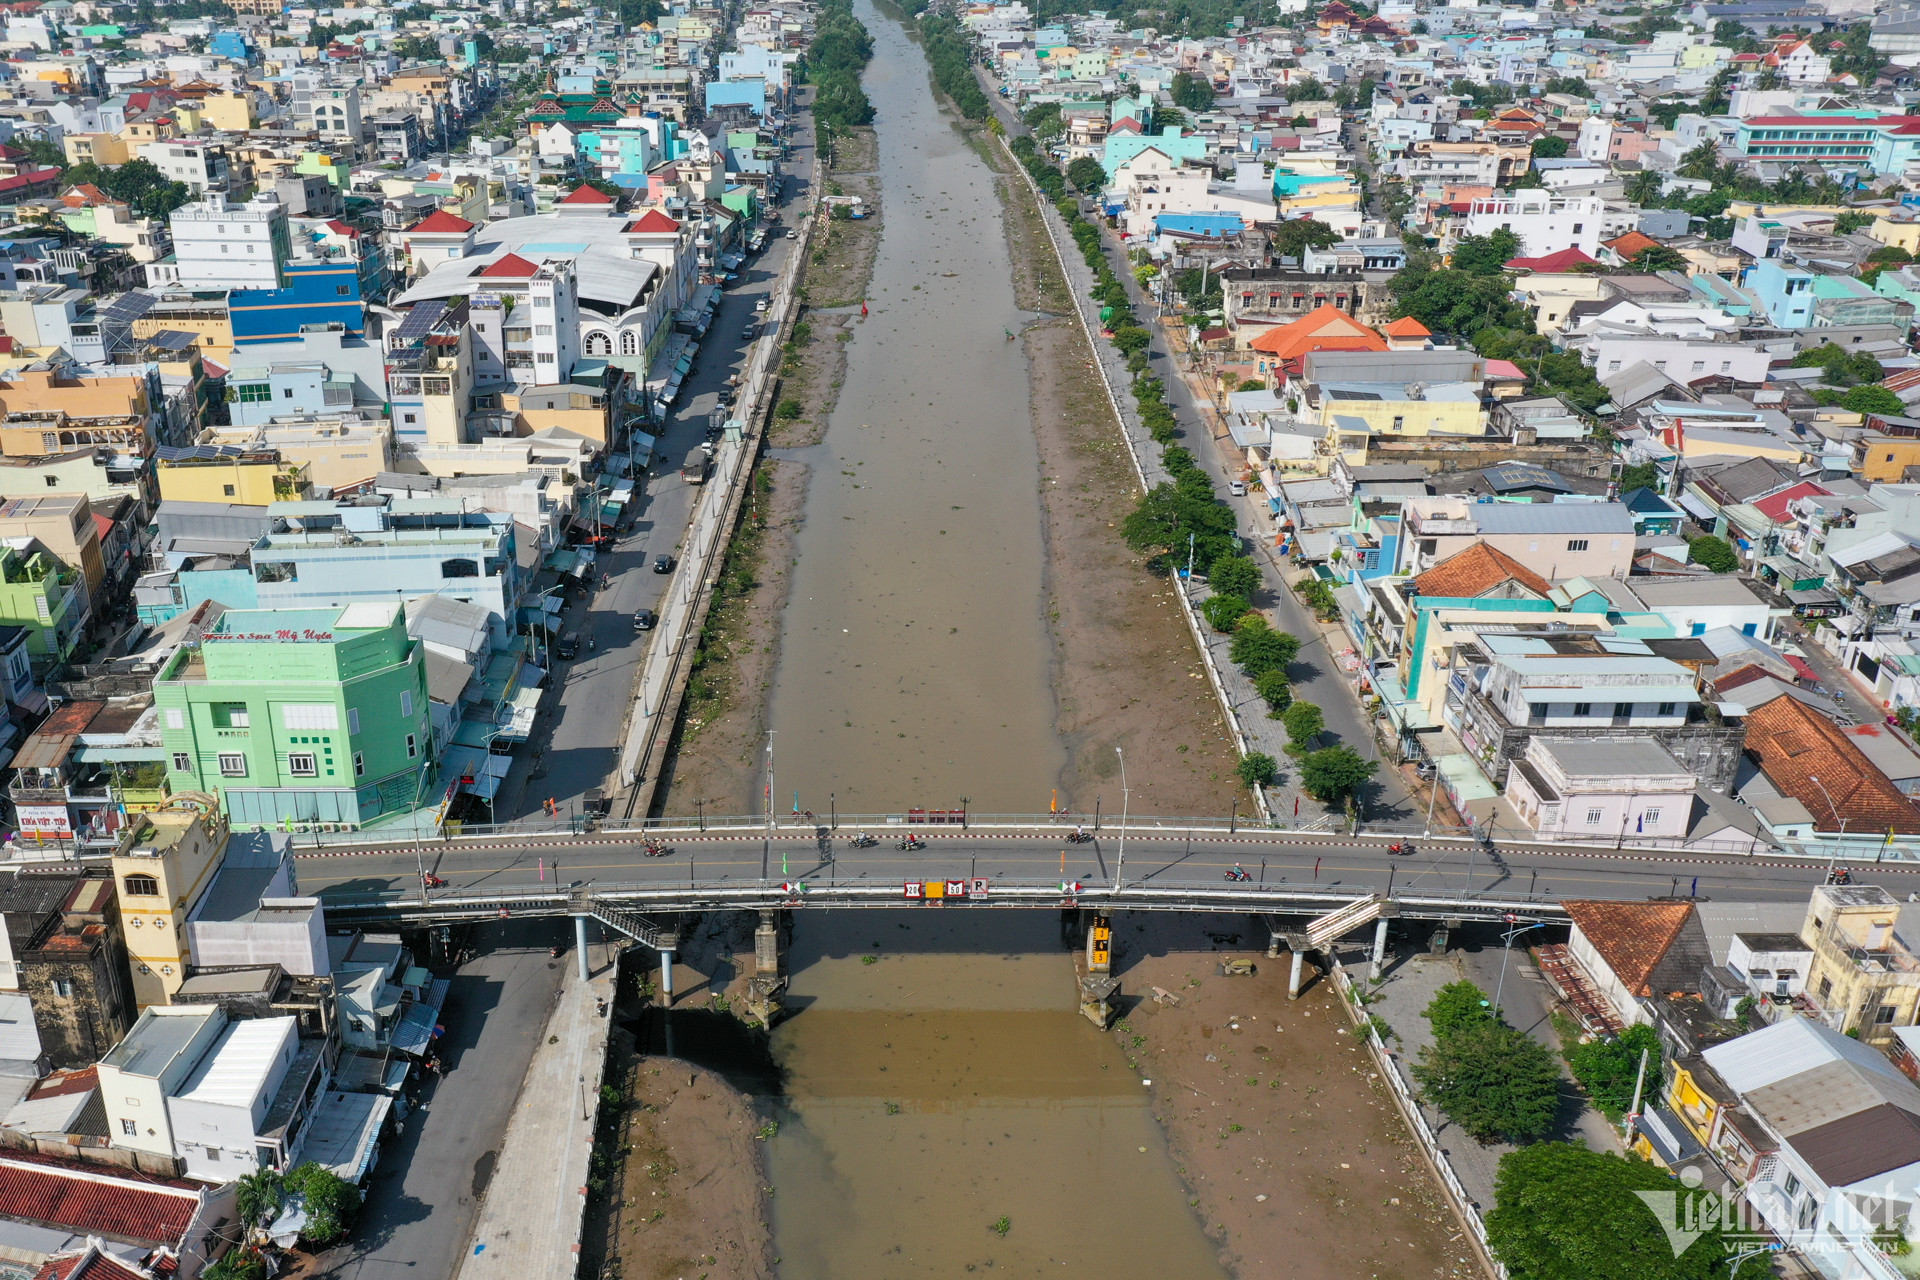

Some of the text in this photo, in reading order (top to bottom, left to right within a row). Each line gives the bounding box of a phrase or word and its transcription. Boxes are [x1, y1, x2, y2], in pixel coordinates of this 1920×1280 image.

[247, 632, 272, 641] Spa
[909, 886, 917, 894] 20
[1100, 930, 1105, 938] 3
[1099, 953, 1103, 962] 5
